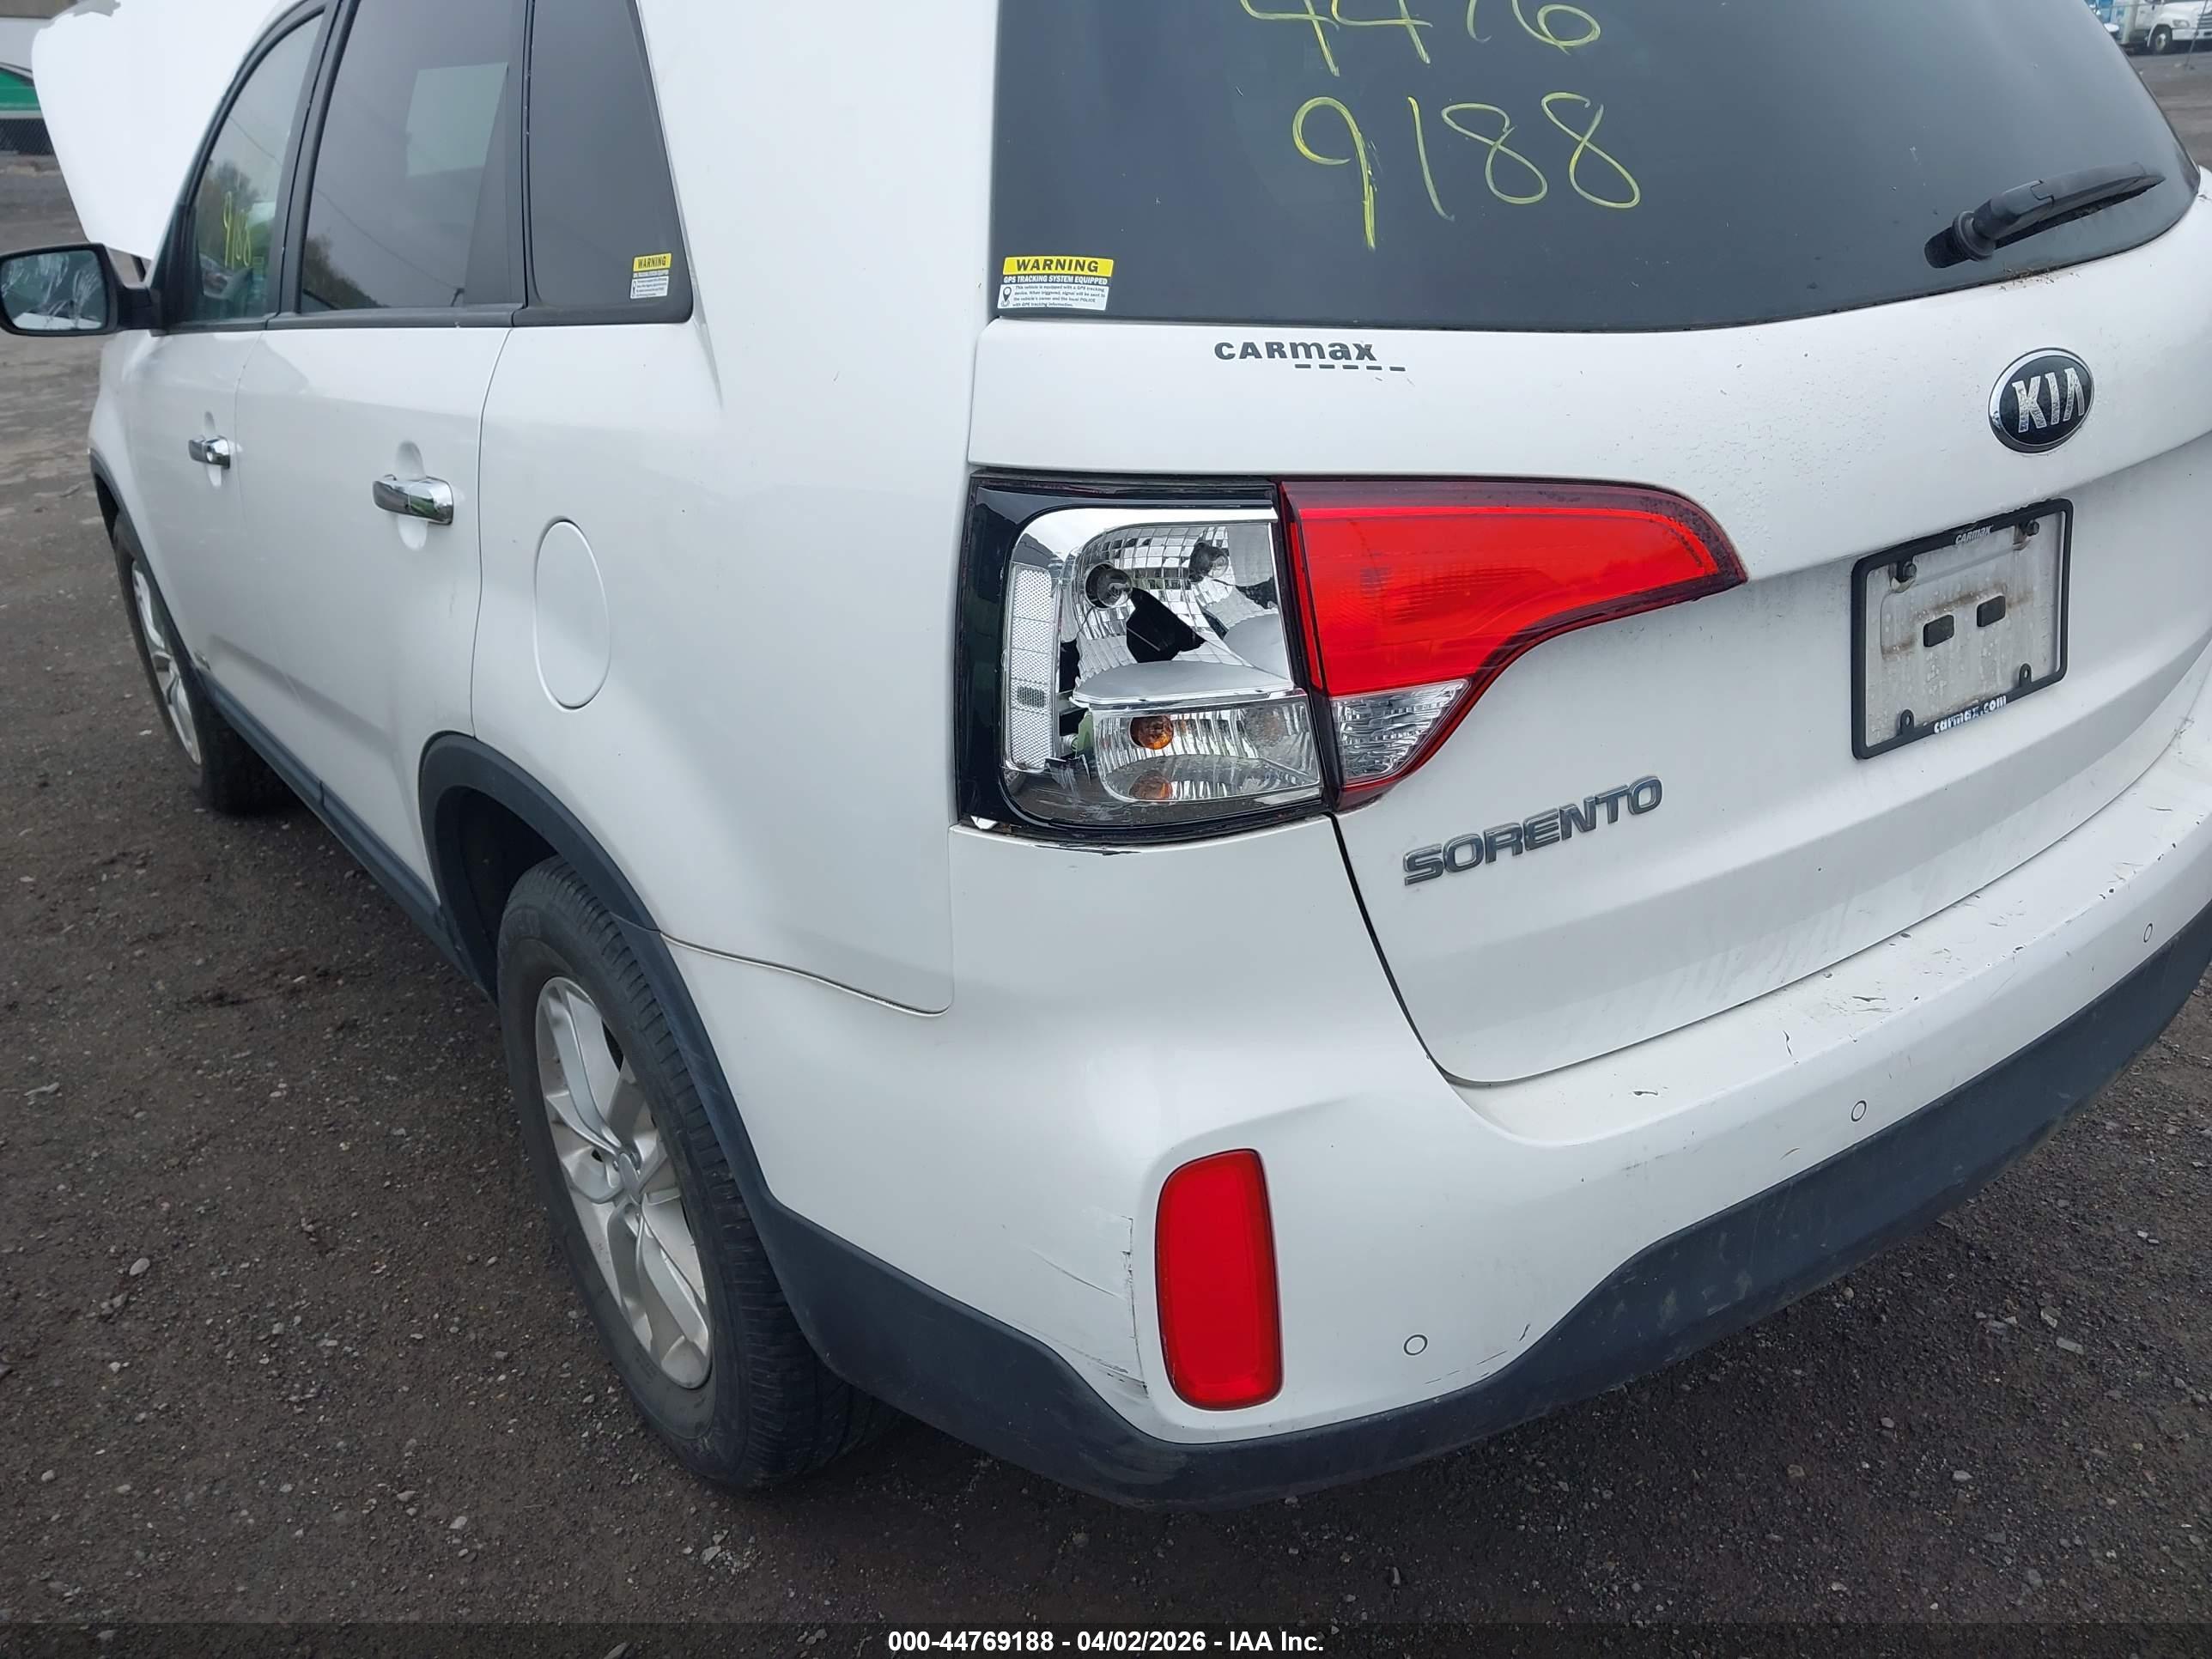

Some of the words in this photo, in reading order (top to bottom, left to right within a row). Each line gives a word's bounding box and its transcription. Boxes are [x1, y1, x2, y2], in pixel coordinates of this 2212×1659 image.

[1291, 91, 1642, 251] 9188
[637, 256, 666, 270] WARNING
[1016, 258, 1099, 273] WARNING
[1074, 276, 1108, 285] EQUIPPED
[2012, 367, 2085, 433] KIA
[1934, 695, 2007, 733] carmax.com
[1403, 775, 1663, 886] SORENTO
